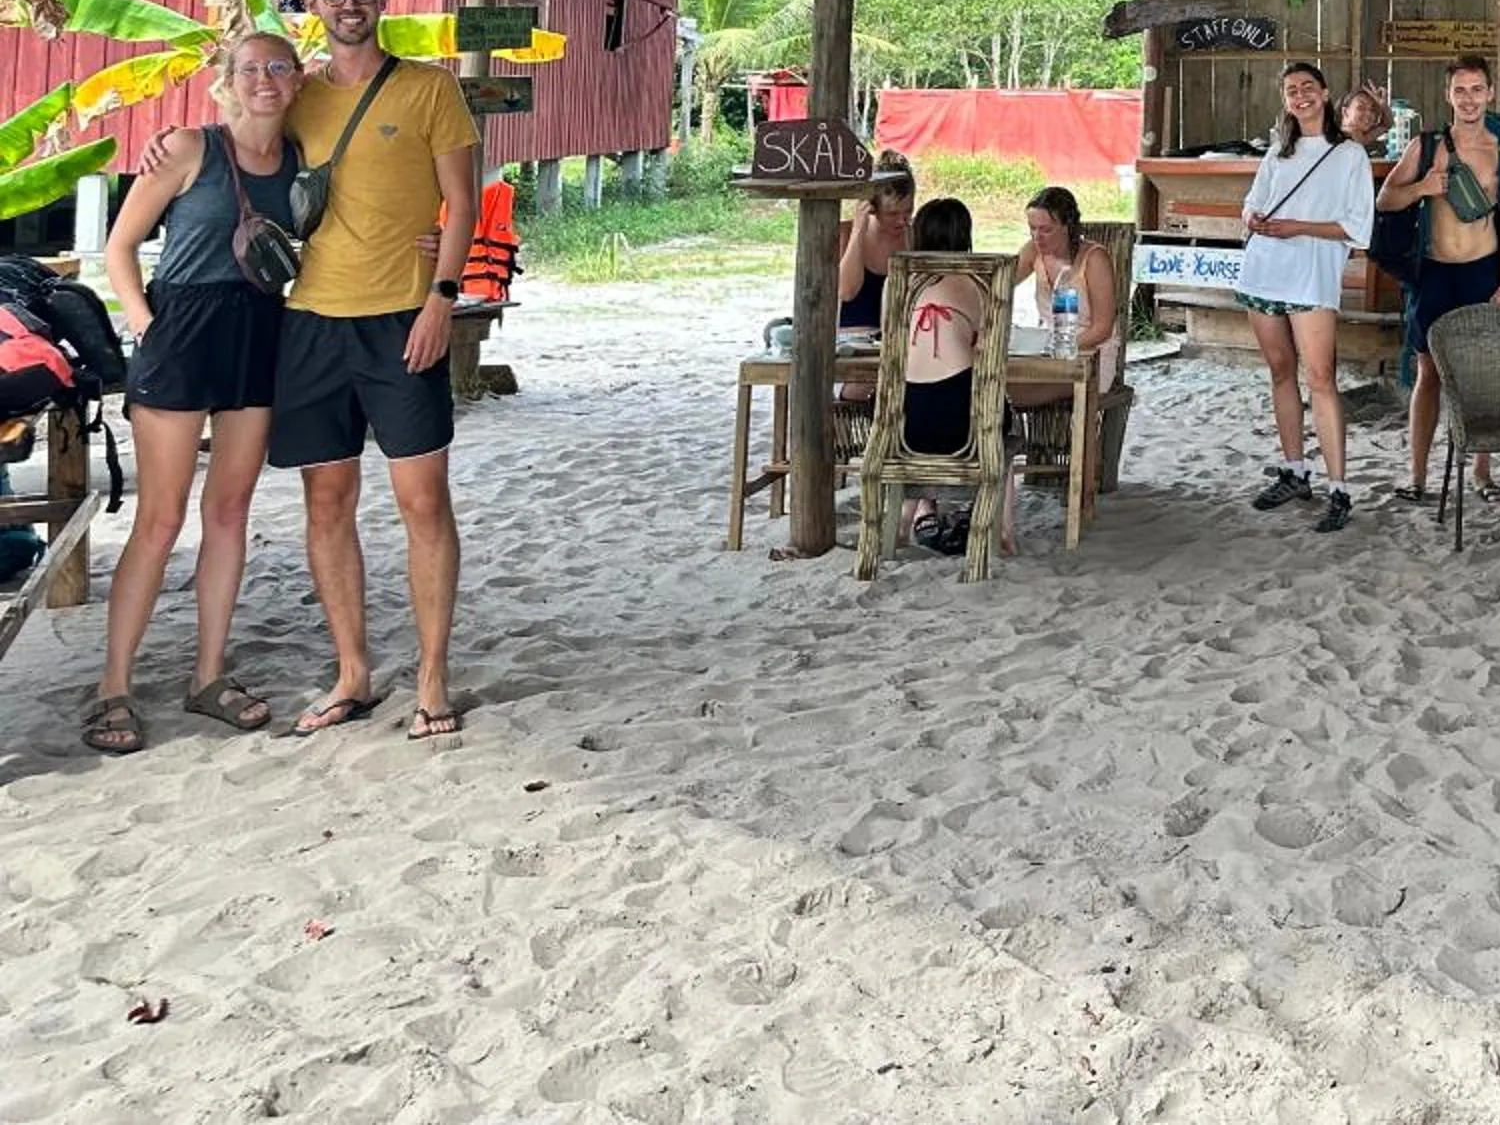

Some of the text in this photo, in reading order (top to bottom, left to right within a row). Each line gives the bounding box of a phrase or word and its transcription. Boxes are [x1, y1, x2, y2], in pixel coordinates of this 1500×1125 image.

[1181, 18, 1275, 49] STAFF ONLY
[1148, 251, 1241, 280] LOVE YOURSE
